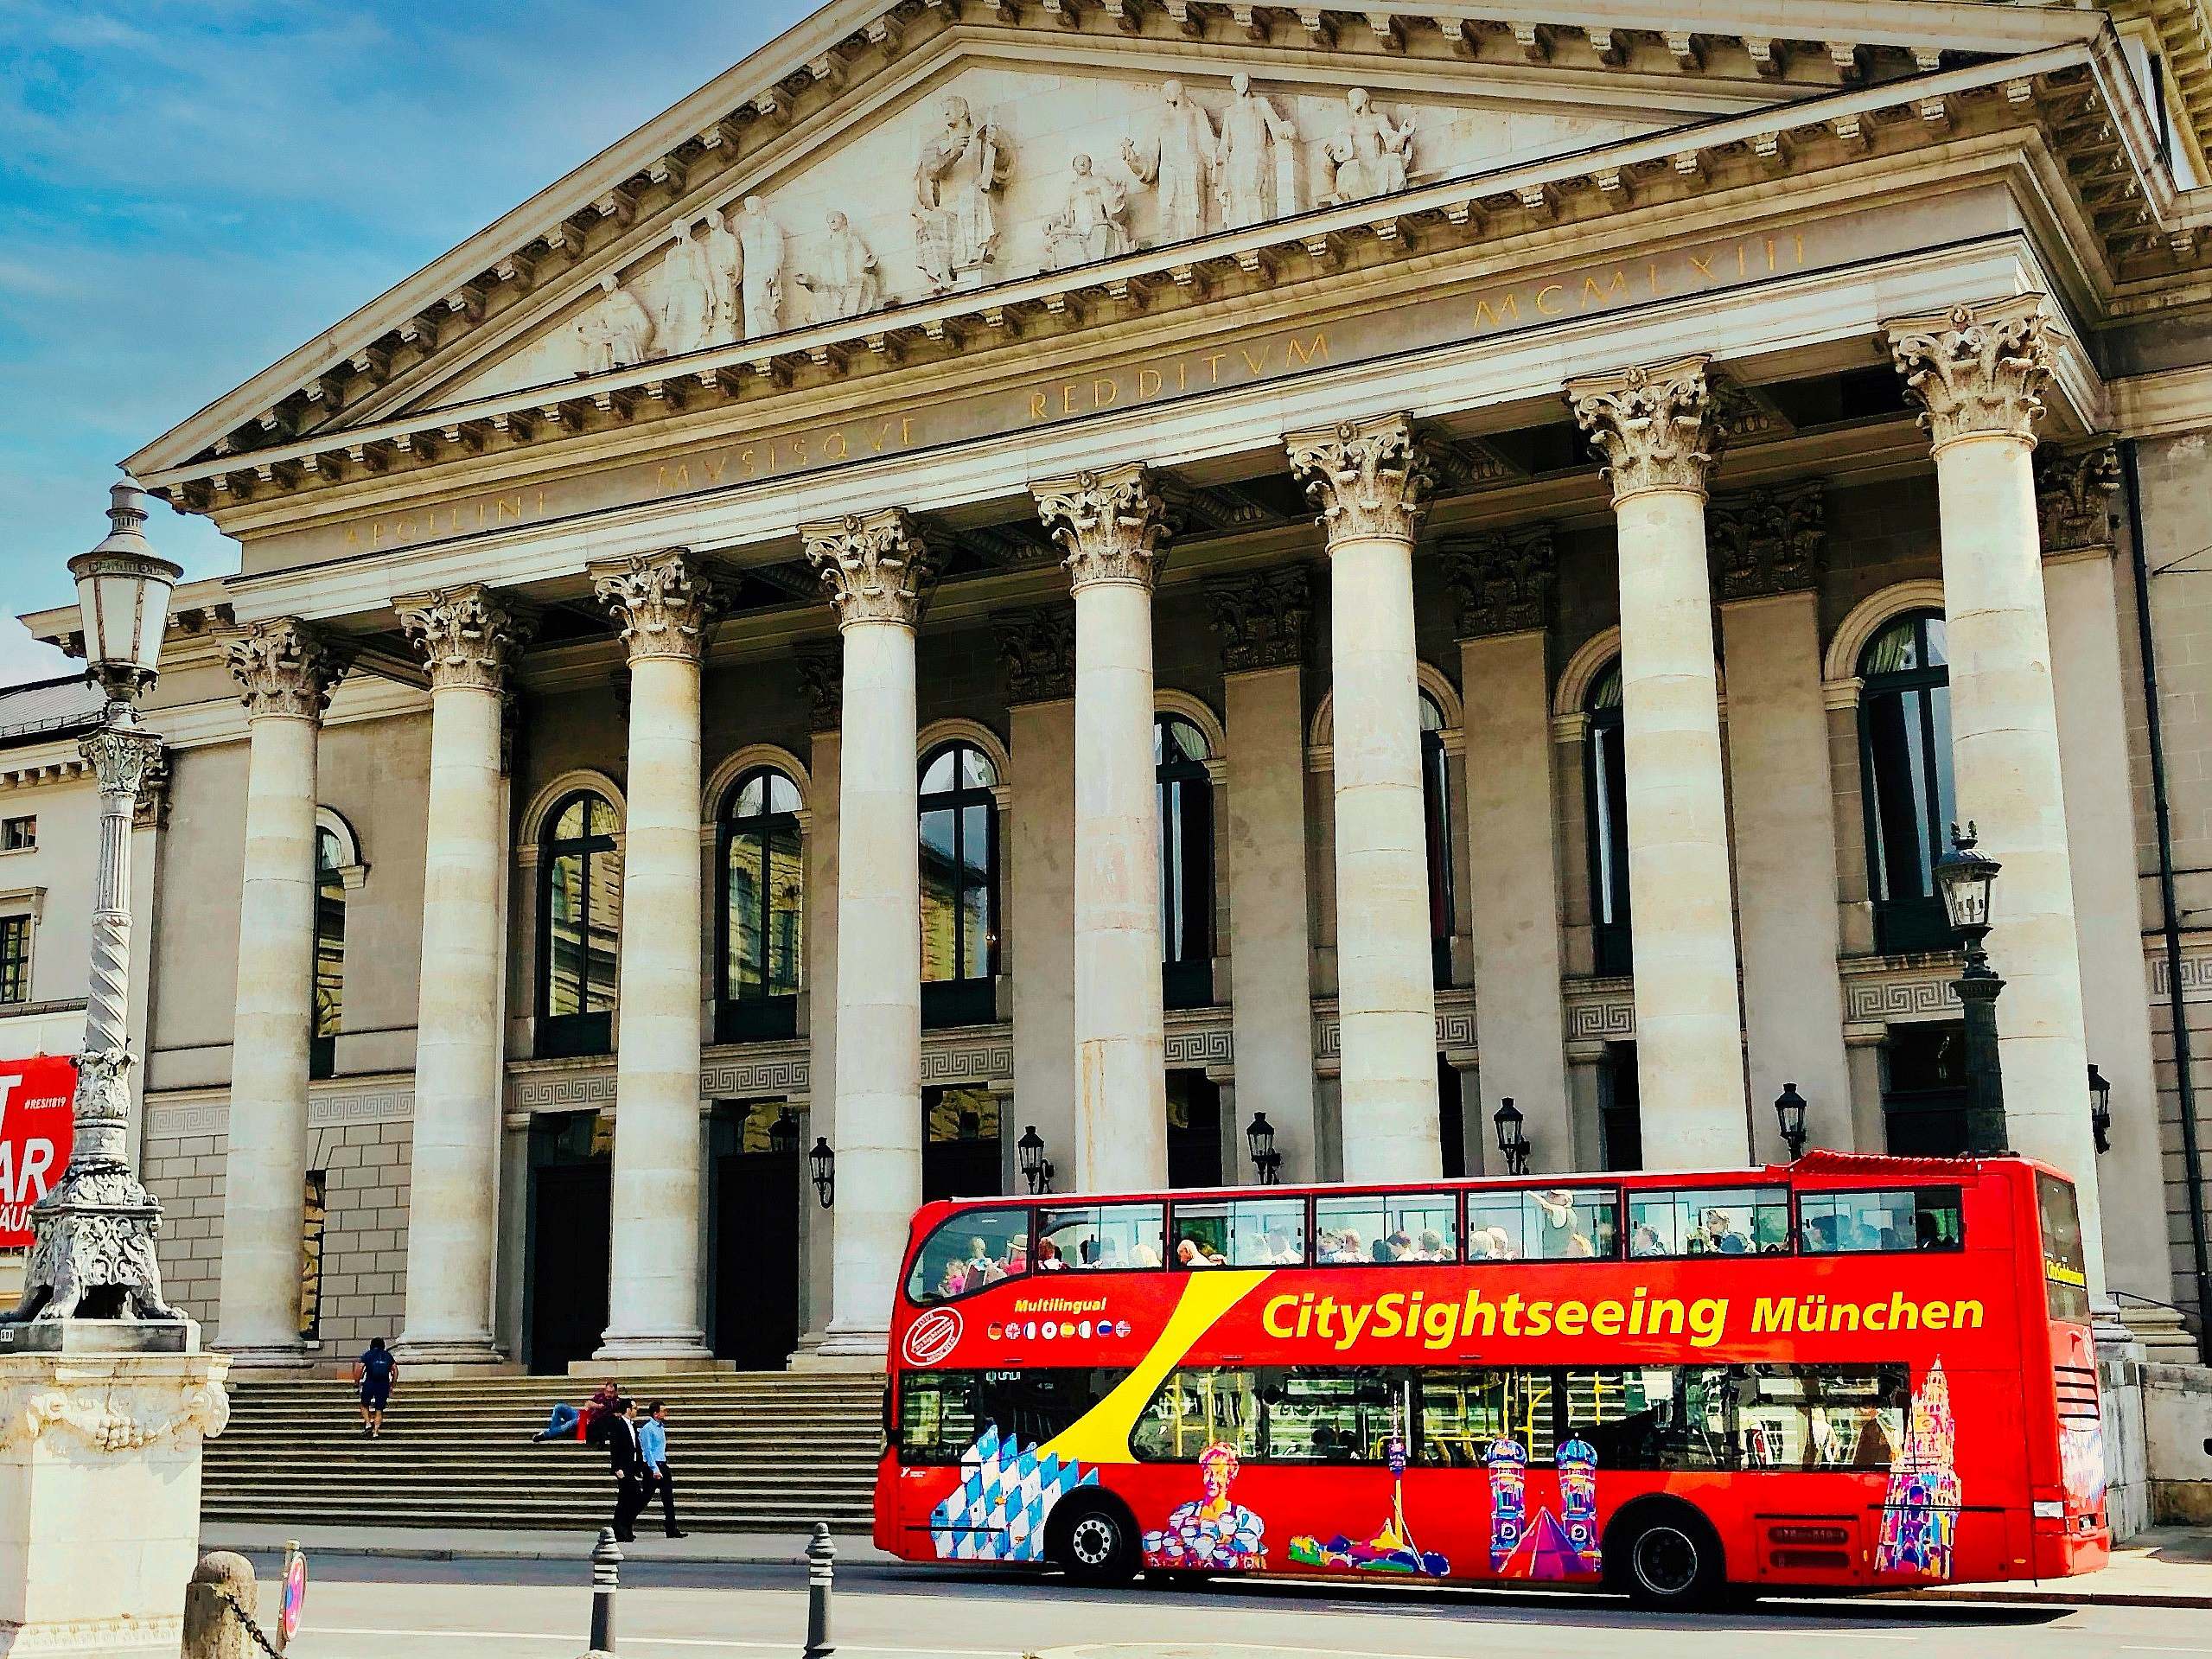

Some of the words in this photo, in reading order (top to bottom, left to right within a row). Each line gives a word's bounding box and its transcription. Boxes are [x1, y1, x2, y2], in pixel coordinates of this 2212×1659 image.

[1031, 332, 1329, 419] REDDITVM
[1473, 233, 1805, 330] MCMLXIII
[25, 1096, 67, 1110] #RESI1819
[1014, 1297, 1107, 1314] Multilingual
[1262, 1287, 1730, 1350] CitySightseeing
[1750, 1292, 1984, 1332] München
